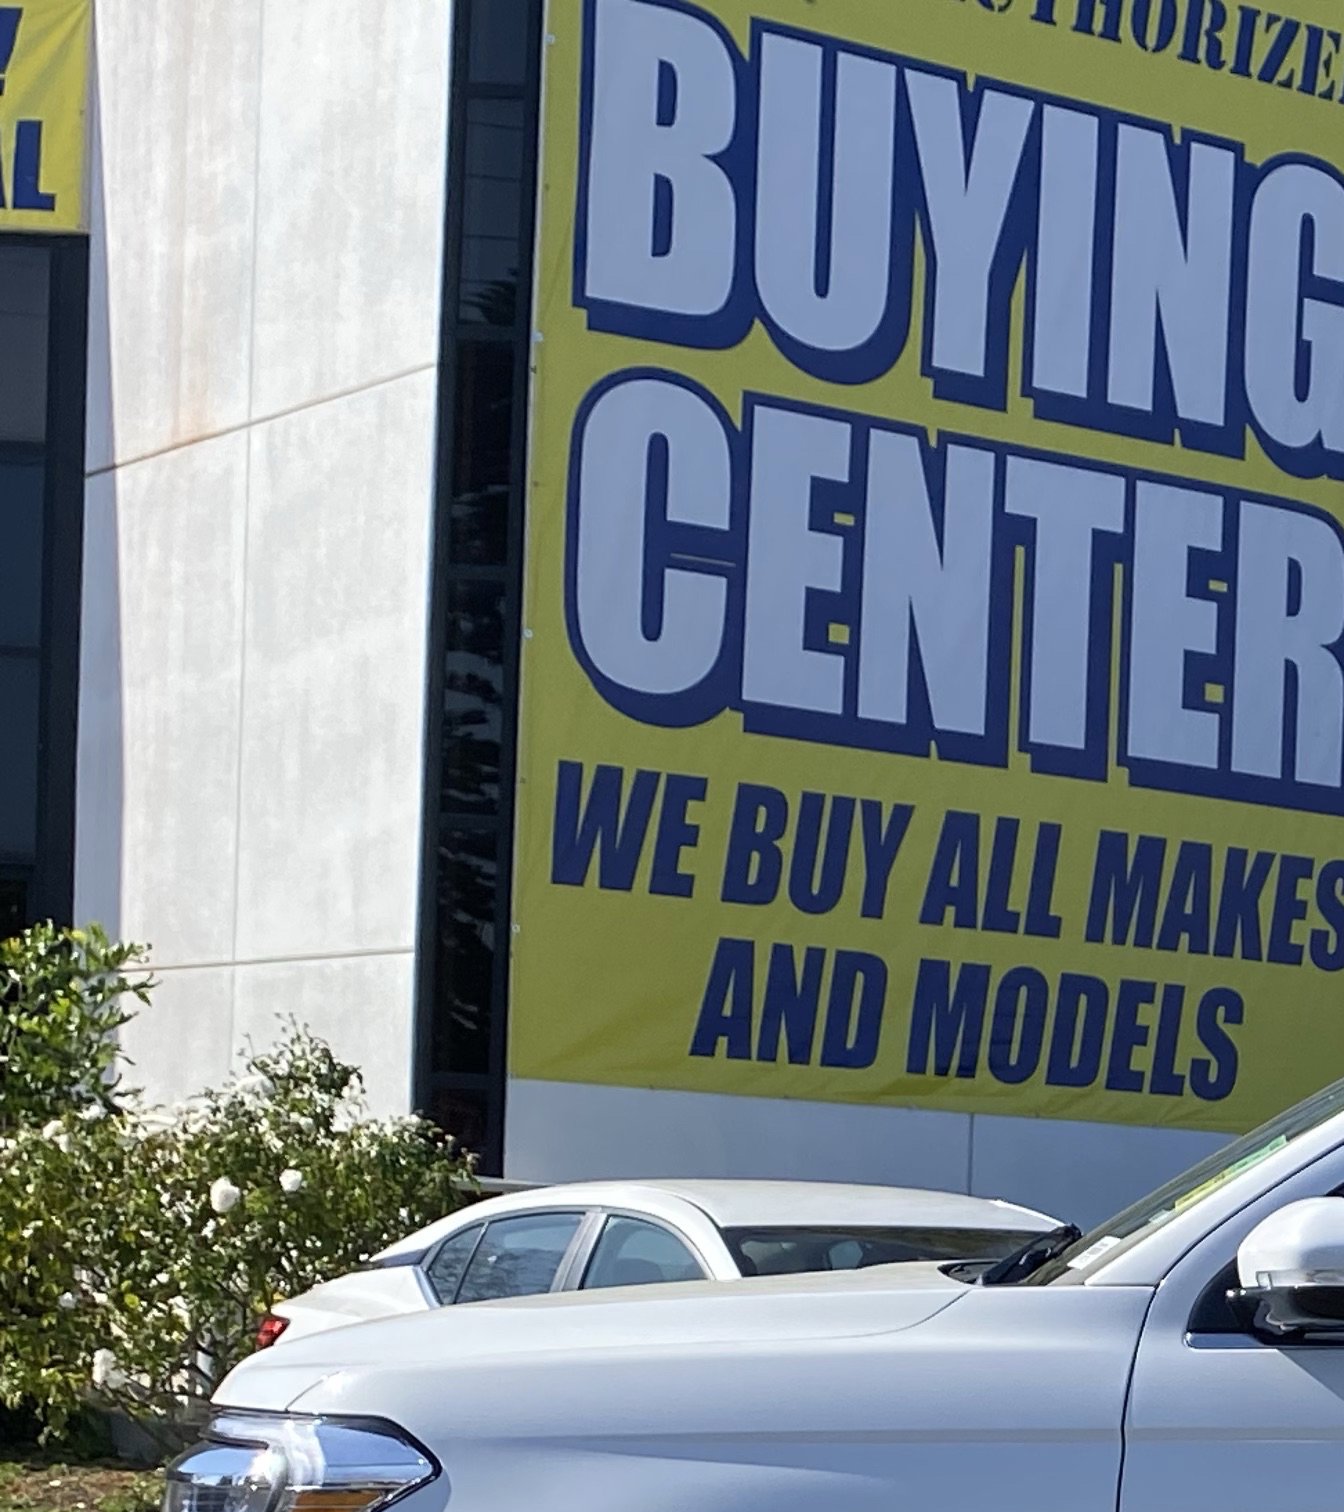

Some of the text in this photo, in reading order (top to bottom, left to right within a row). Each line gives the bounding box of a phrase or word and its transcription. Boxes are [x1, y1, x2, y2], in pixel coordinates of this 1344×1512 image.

[550, 760, 708, 898] WE
[720, 781, 917, 920] BUY
[918, 810, 1063, 940] ALL
[688, 936, 1245, 1102] AND MODELS
